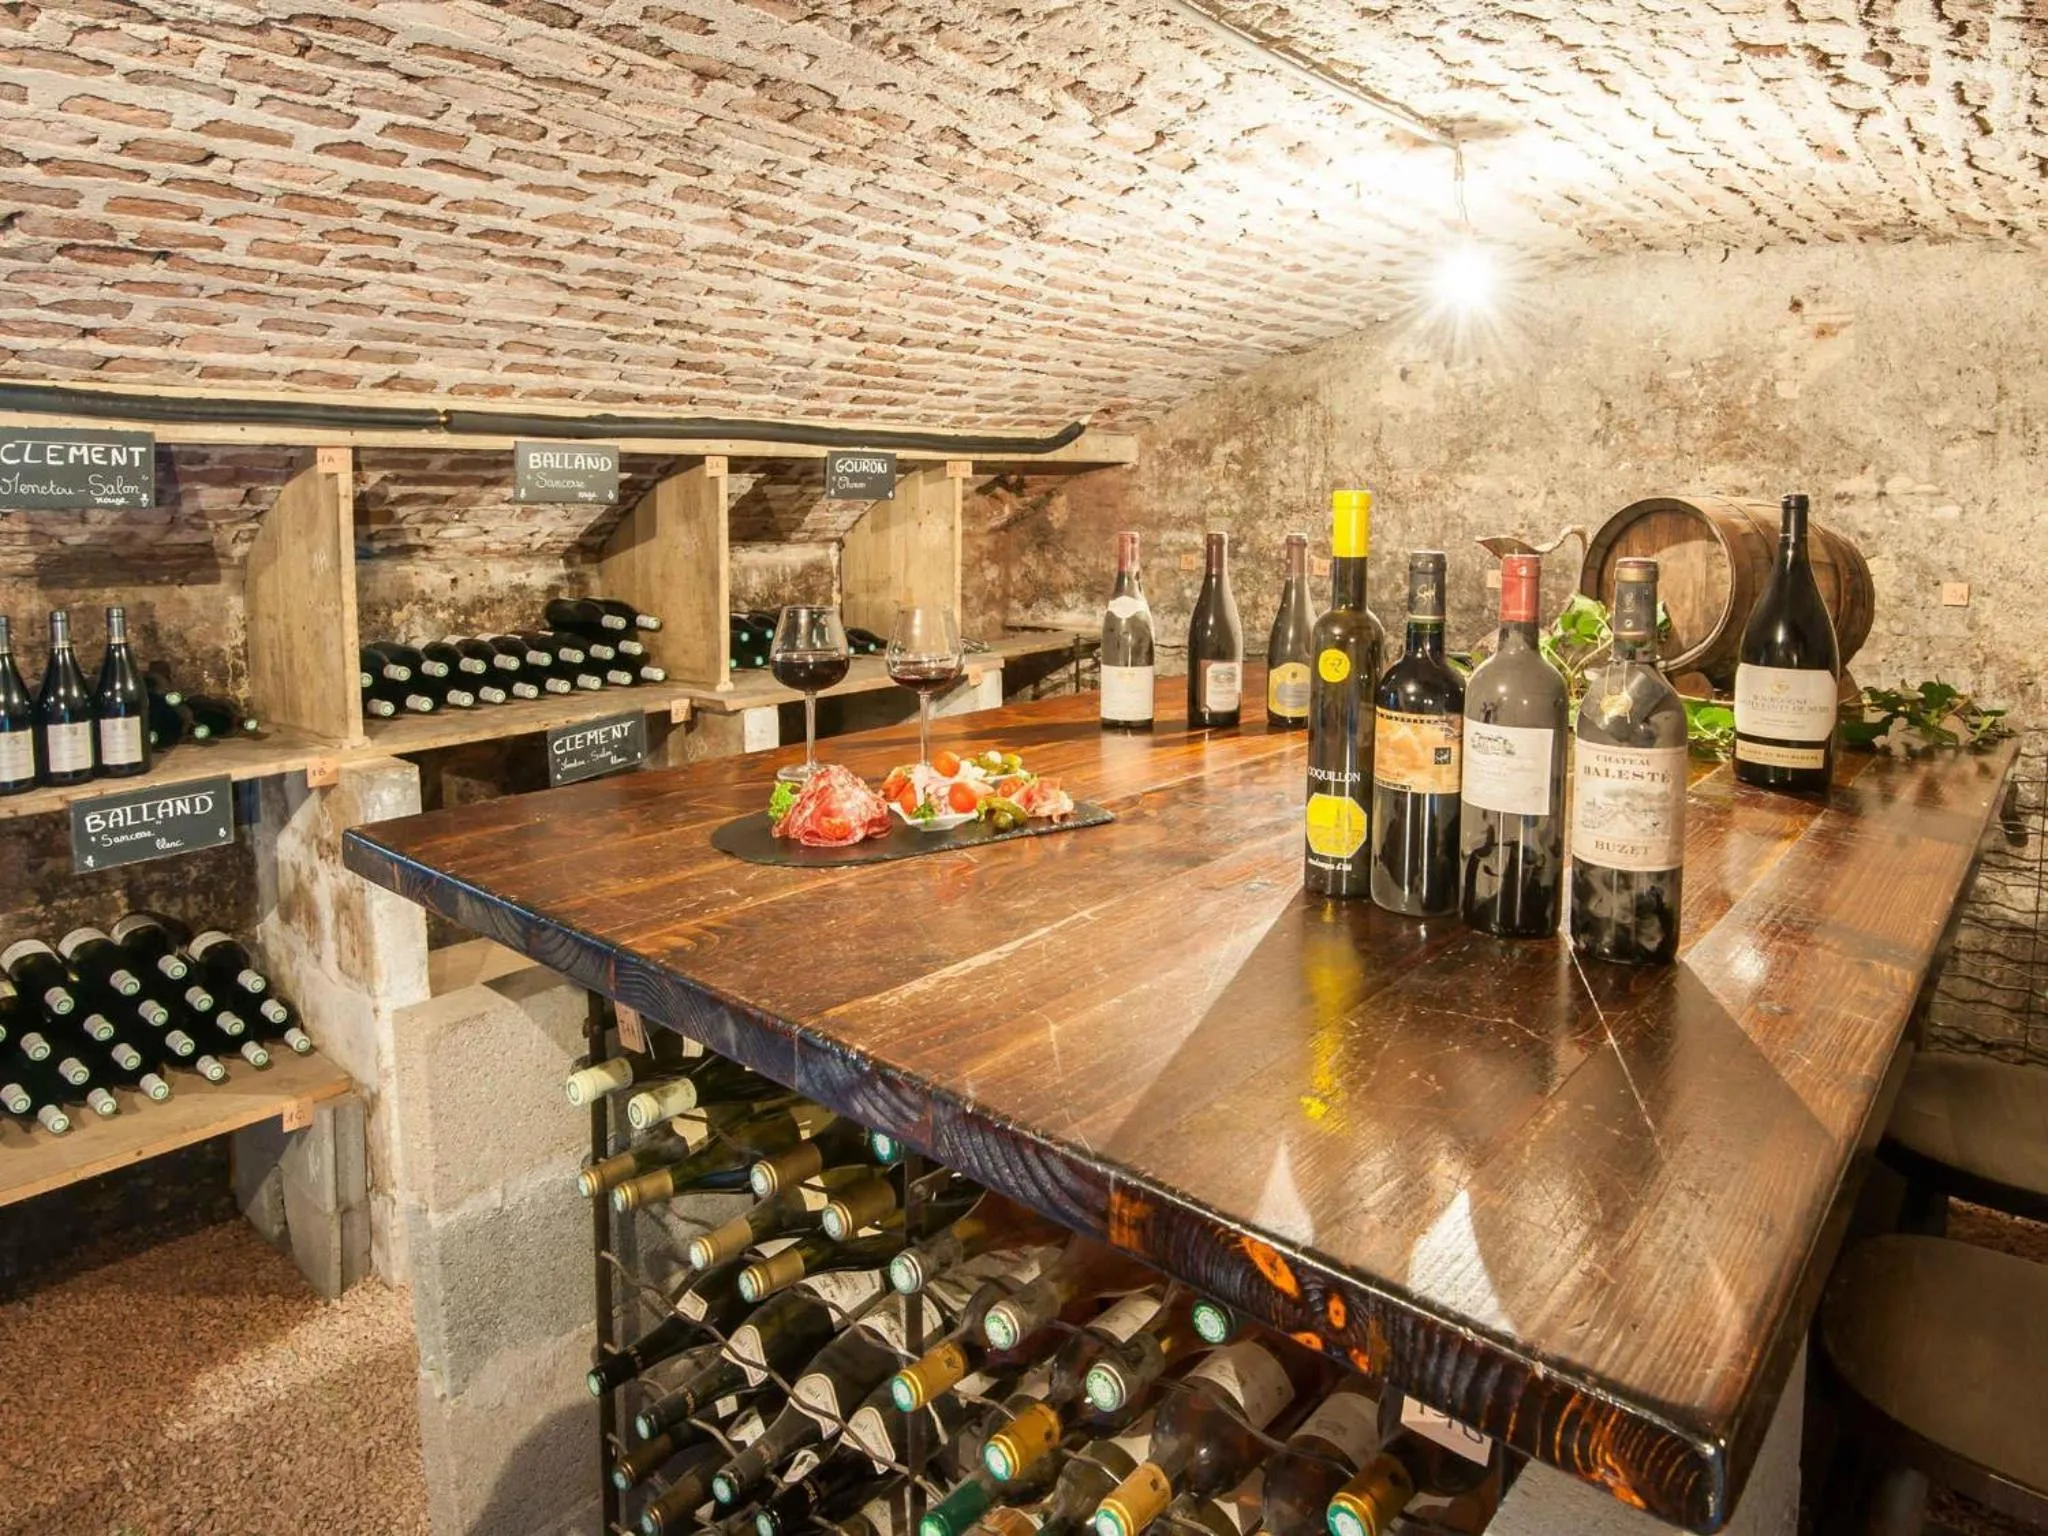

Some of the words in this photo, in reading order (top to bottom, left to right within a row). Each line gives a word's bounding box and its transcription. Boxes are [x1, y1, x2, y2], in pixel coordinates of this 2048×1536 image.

[0, 442, 147, 467] CLEMENT
[528, 452, 613, 472] BALLAND
[835, 459, 888, 474] GOURON
[84, 793, 214, 834] BALLAND
